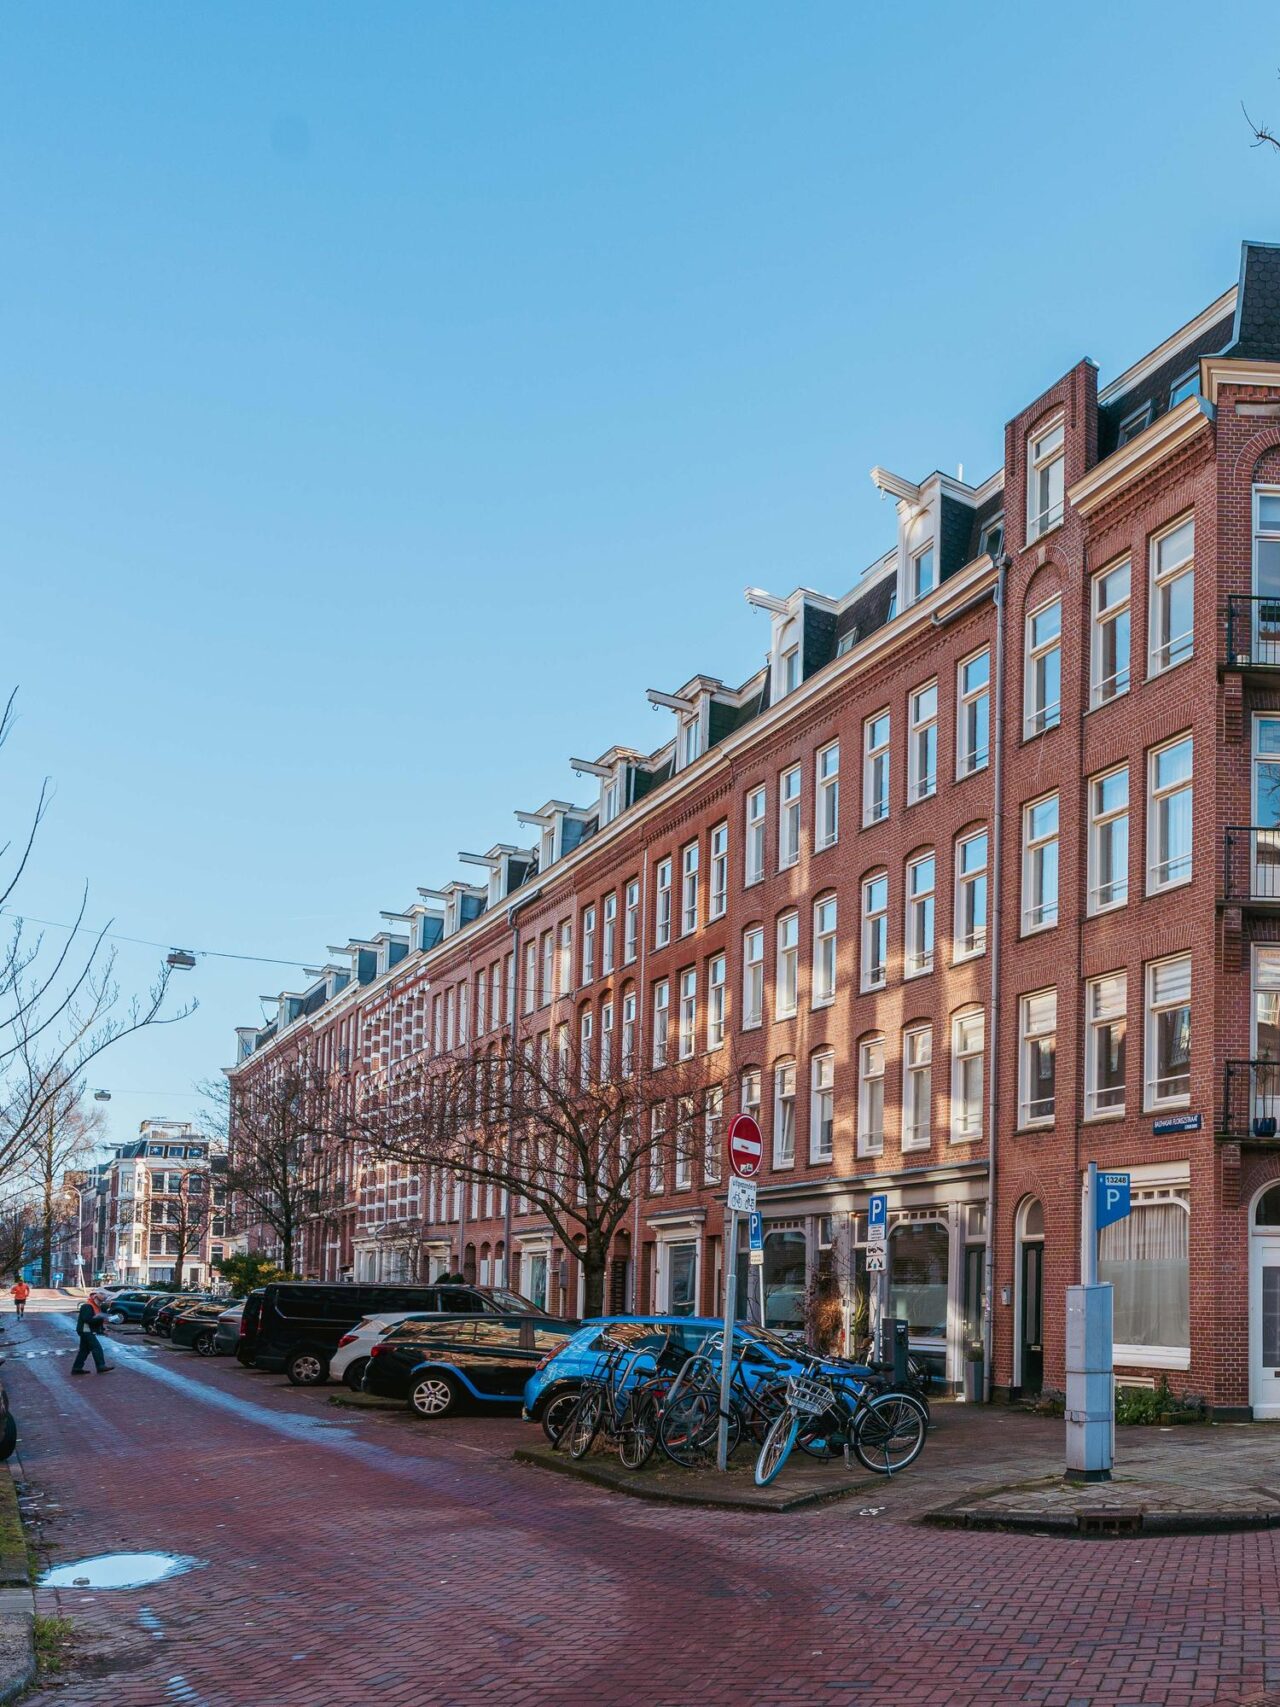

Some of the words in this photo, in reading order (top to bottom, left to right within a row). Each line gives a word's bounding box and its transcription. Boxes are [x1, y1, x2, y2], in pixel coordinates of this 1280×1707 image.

[1106, 1176, 1127, 1184] 13248
[1107, 1189, 1120, 1210] P
[872, 1200, 882, 1222] P
[751, 1214, 758, 1235] P
